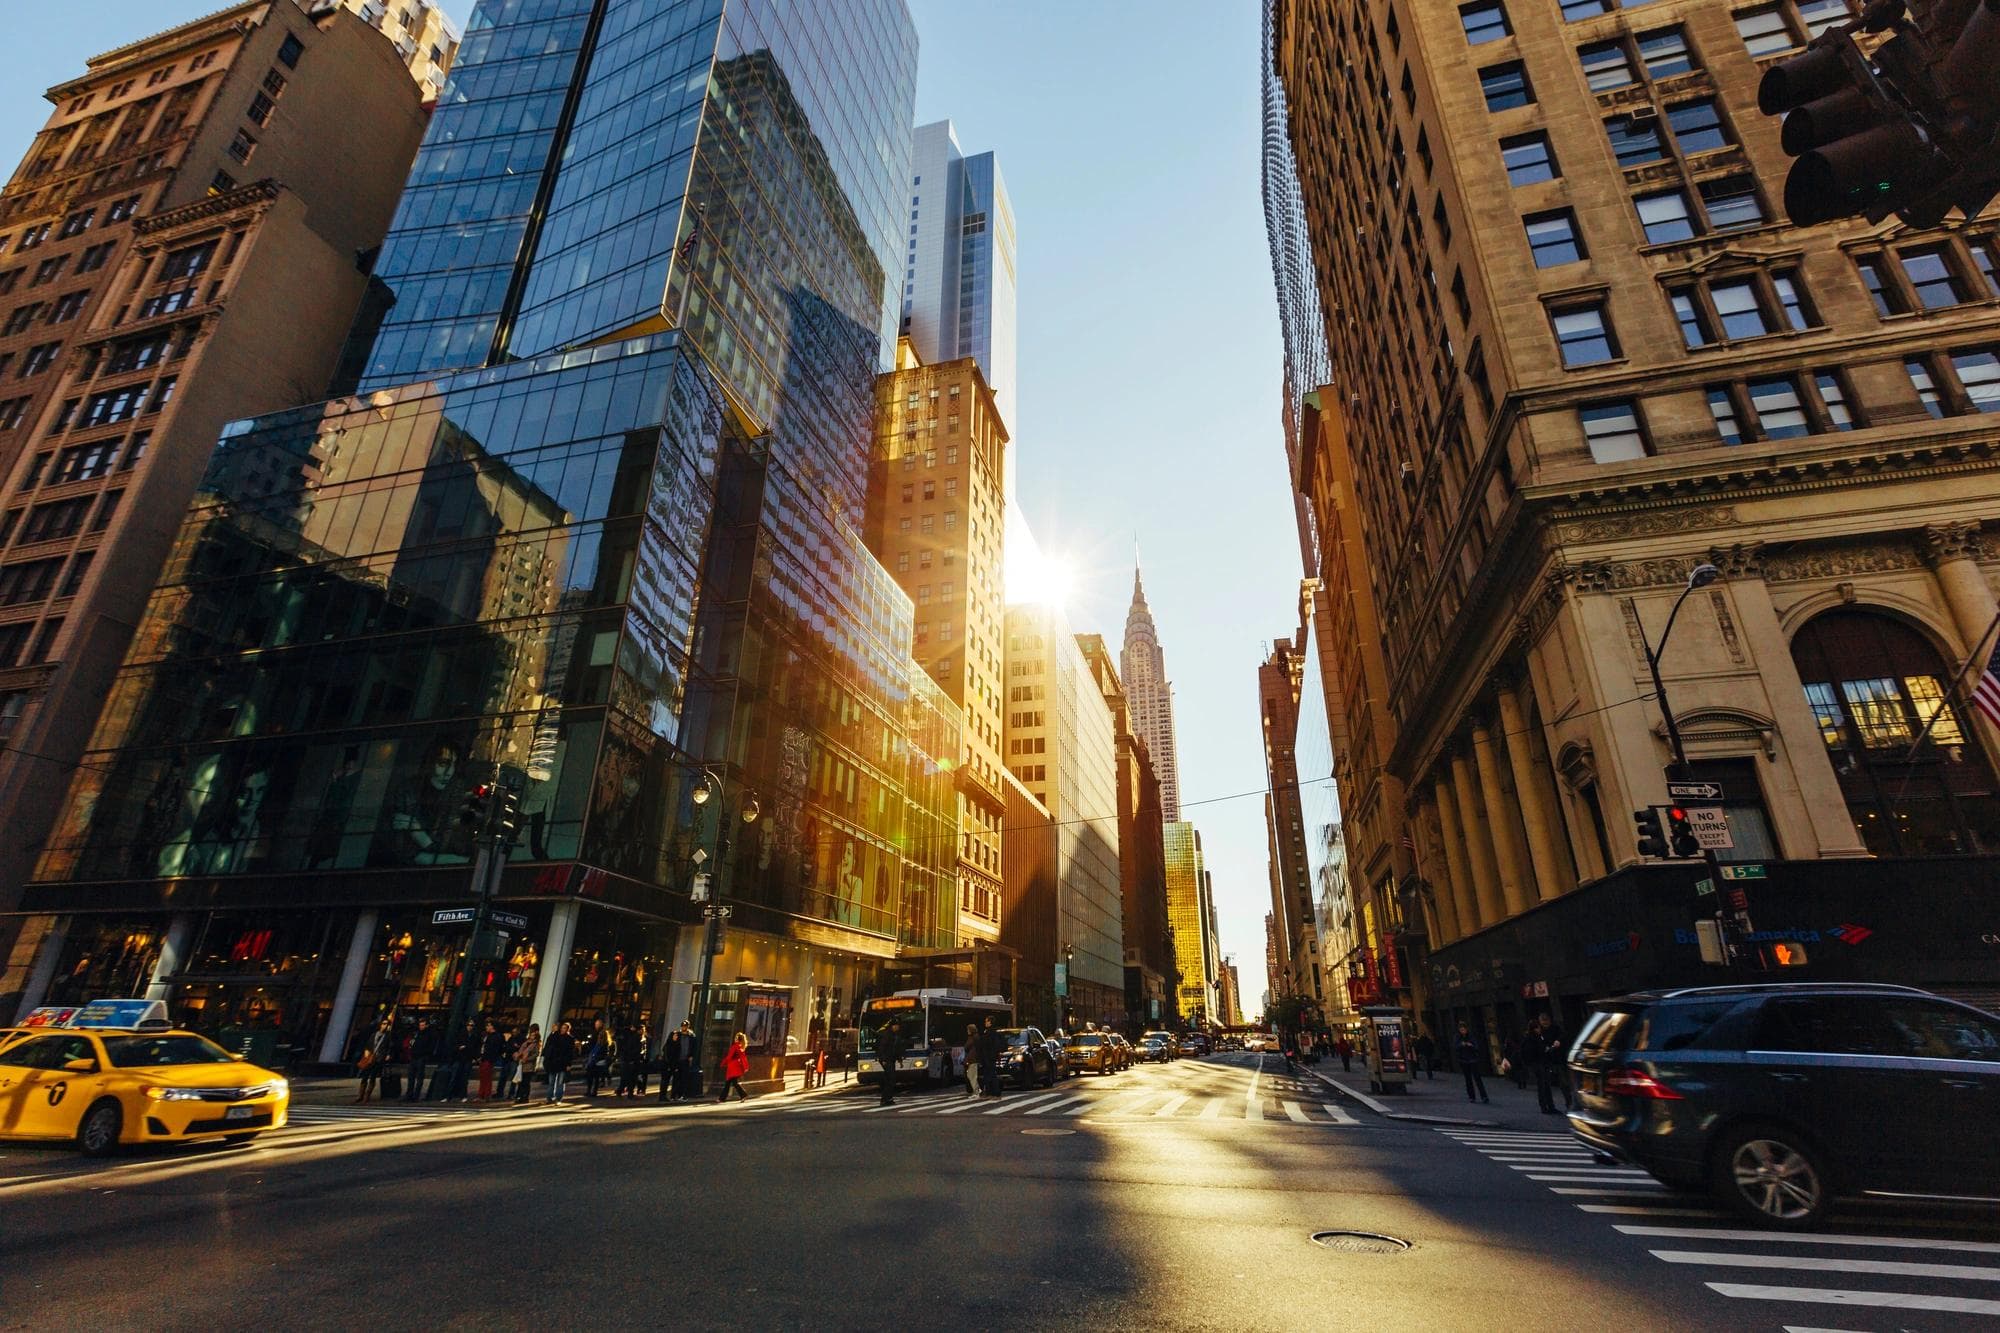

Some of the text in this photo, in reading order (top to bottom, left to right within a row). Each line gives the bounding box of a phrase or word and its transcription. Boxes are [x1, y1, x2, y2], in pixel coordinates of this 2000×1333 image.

[1697, 787, 1713, 795] WAY
[1697, 812, 1715, 821] NO
[1691, 822, 1727, 831] TURNS
[1737, 867, 1746, 878] 5
[437, 911, 469, 921] Fifth Ave
